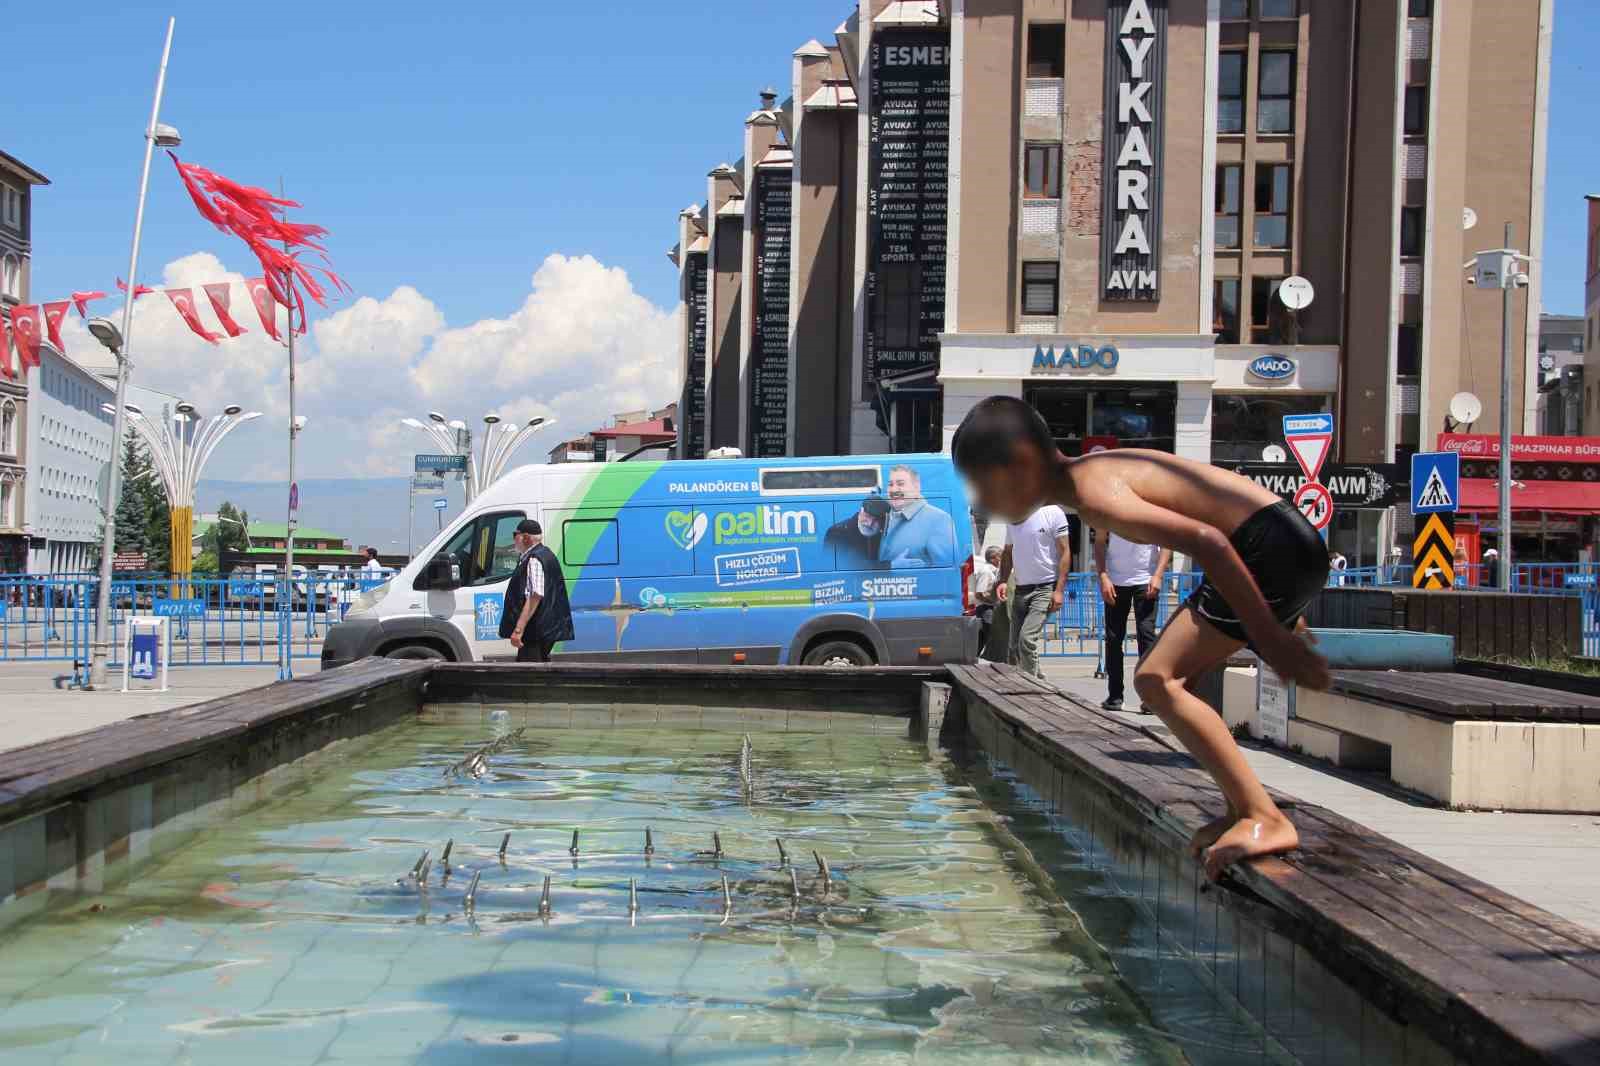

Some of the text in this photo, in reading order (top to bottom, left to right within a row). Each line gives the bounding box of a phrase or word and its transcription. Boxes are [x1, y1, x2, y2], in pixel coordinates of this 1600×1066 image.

[884, 100, 917, 108] AVUKAT
[1107, 270, 1157, 290] AVM
[1032, 344, 1120, 369] MADO
[1254, 360, 1292, 372] MADO
[1492, 444, 1572, 454] DRMAZPINAR
[668, 480, 748, 493] PALANDÖKEN
[1328, 476, 1366, 494] AVM
[714, 504, 816, 545] paltim
[726, 552, 786, 568] HIZLI ÇÖZÜM
[736, 567, 778, 580] NOKTASI
[862, 580, 918, 596] Sunar
